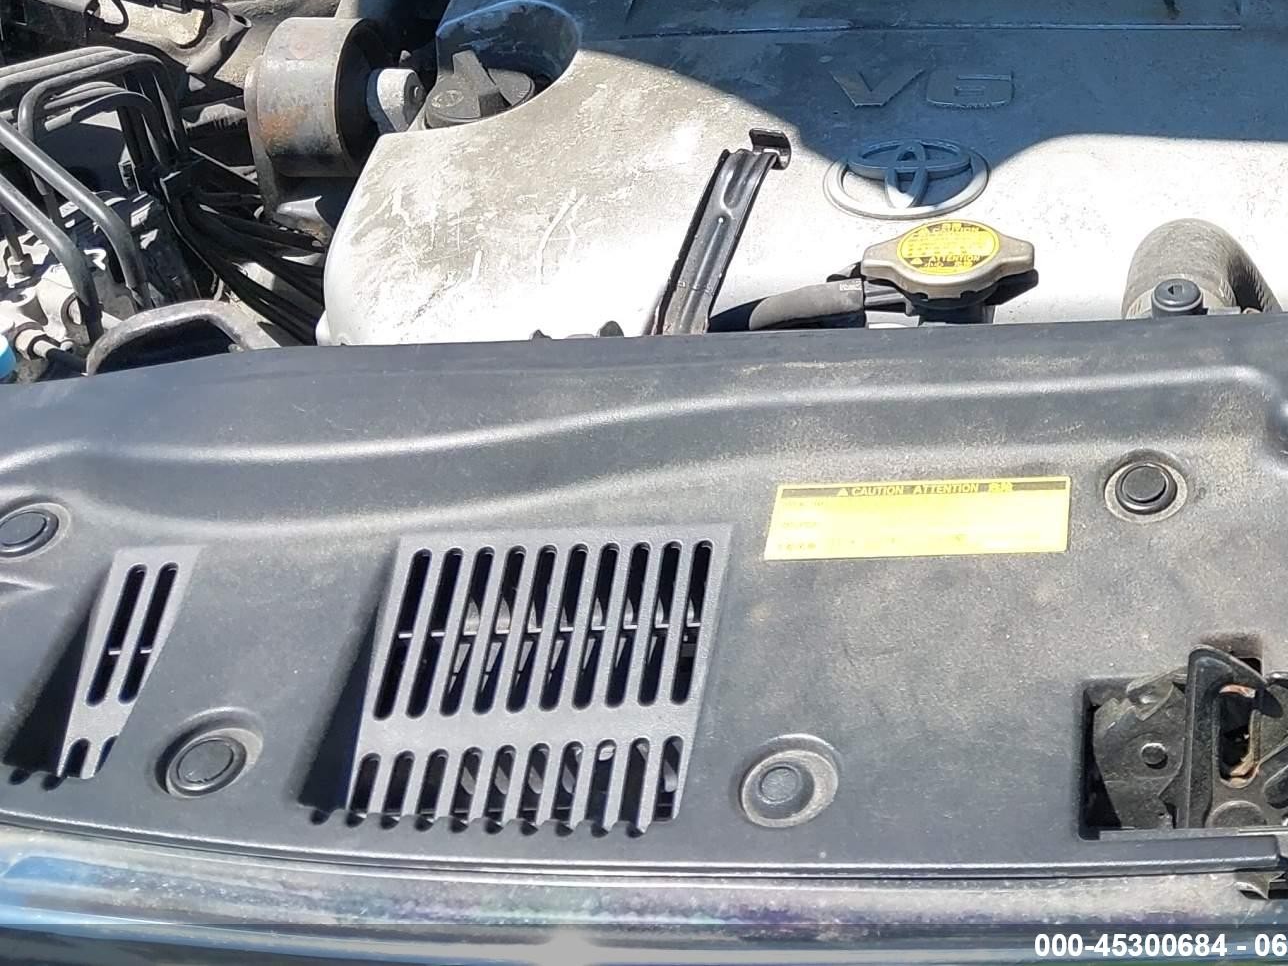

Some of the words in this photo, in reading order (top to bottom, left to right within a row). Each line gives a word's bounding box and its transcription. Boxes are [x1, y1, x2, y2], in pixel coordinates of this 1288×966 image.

[828, 67, 1016, 109] V6
[929, 254, 981, 262] ATTENTION
[851, 485, 905, 497] CAUTION
[912, 483, 979, 495] ATTENTION
